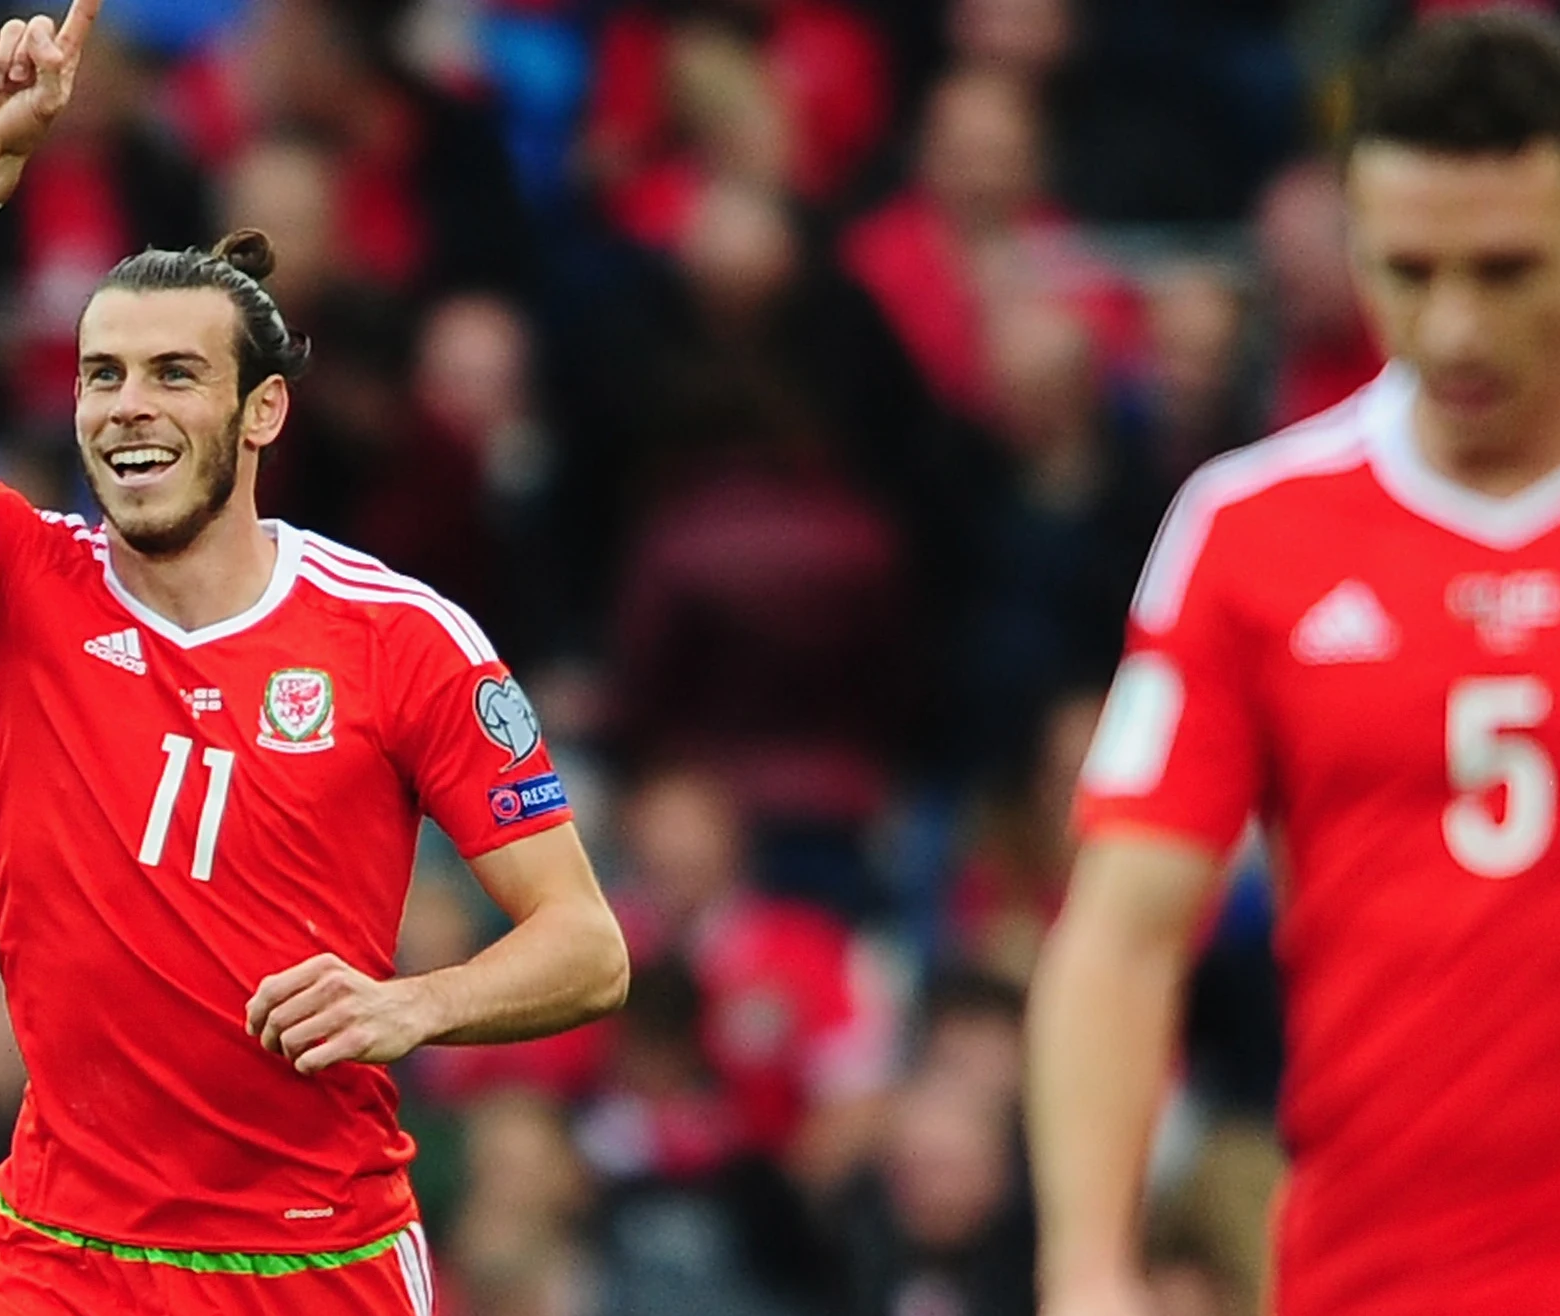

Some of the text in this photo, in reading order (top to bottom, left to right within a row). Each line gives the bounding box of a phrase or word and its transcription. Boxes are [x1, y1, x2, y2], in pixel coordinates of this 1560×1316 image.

[83, 639, 148, 676] adidas
[138, 732, 236, 882] 11
[1441, 672, 1559, 879] 5
